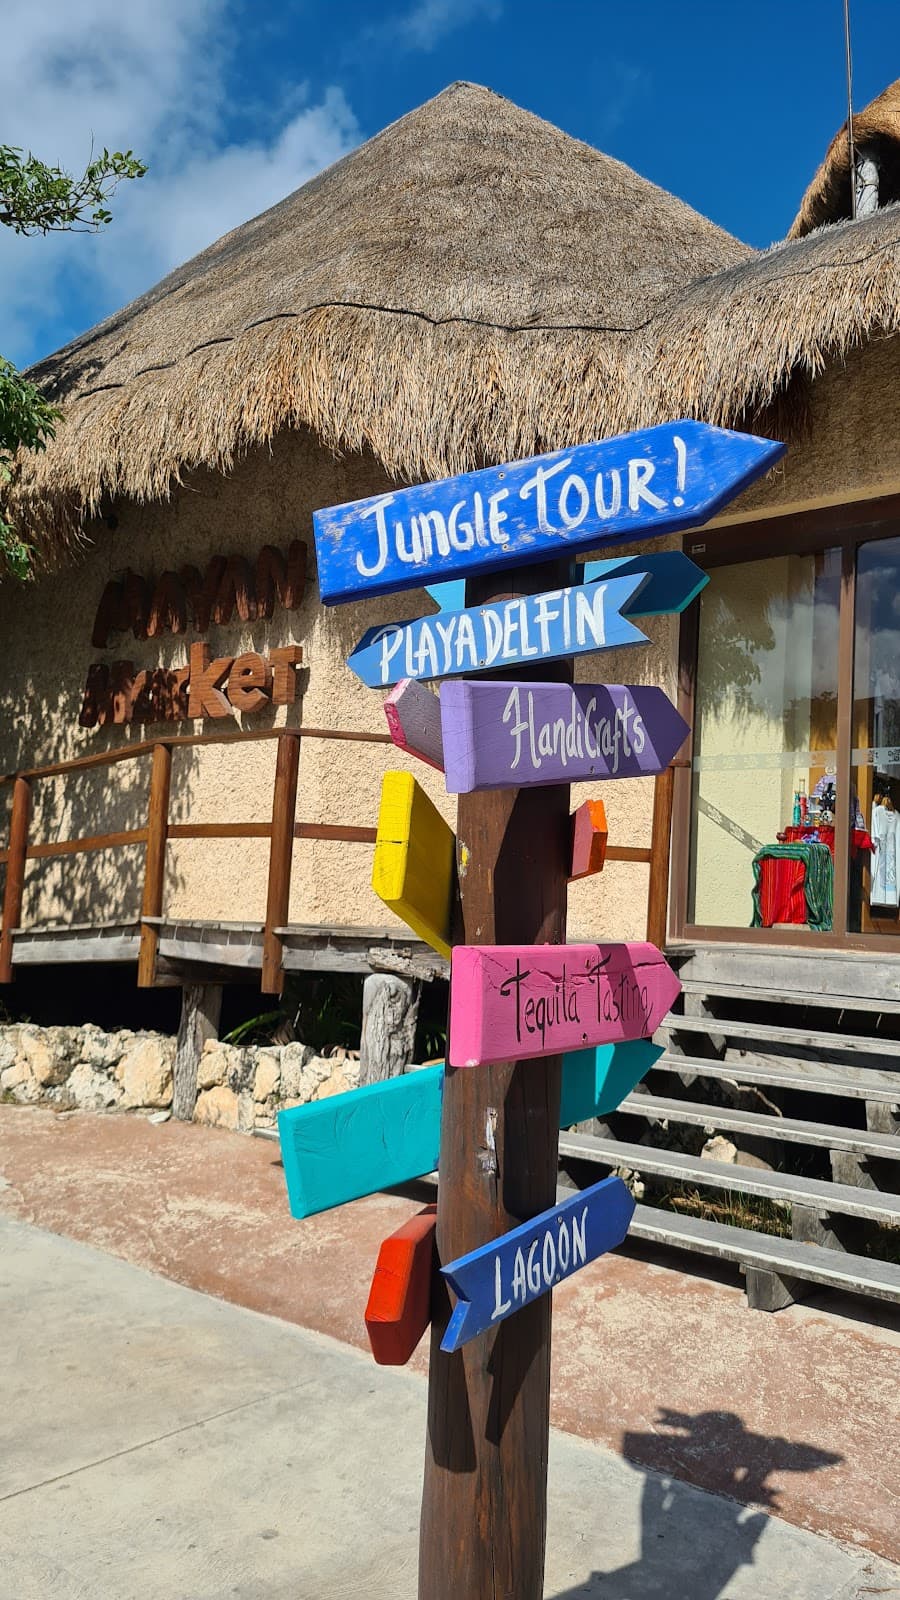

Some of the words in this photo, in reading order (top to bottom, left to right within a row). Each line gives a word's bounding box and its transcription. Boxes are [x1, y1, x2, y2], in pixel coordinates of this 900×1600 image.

[519, 435, 688, 537] TOUR!
[370, 613, 478, 684] PLAYA
[500, 957, 581, 1051] Tequila
[588, 953, 655, 1038] Tasting
[490, 1205, 589, 1321] LAGOON
